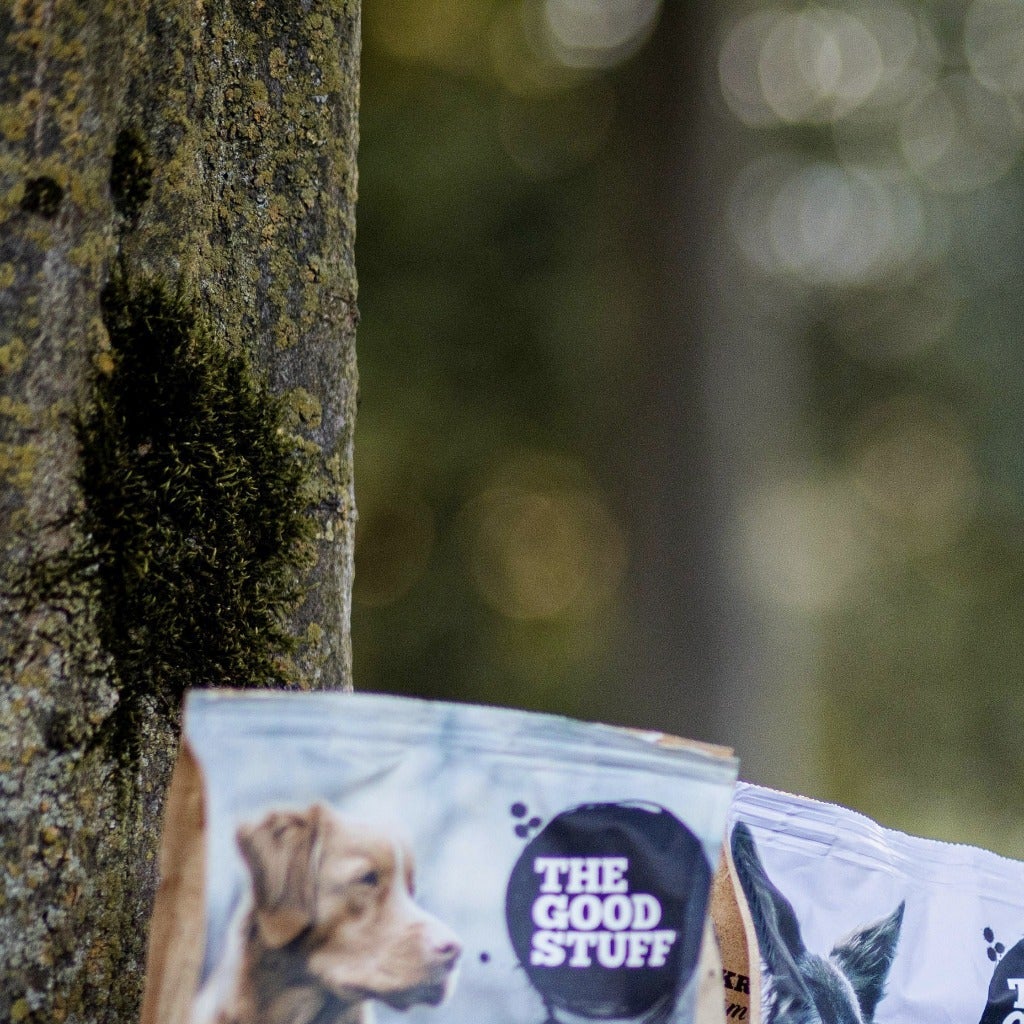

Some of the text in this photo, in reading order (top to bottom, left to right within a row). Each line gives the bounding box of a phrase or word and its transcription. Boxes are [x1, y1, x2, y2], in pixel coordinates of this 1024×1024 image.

[533, 856, 628, 895] THE
[530, 894, 662, 931] GOOD
[530, 929, 677, 968] STUFF
